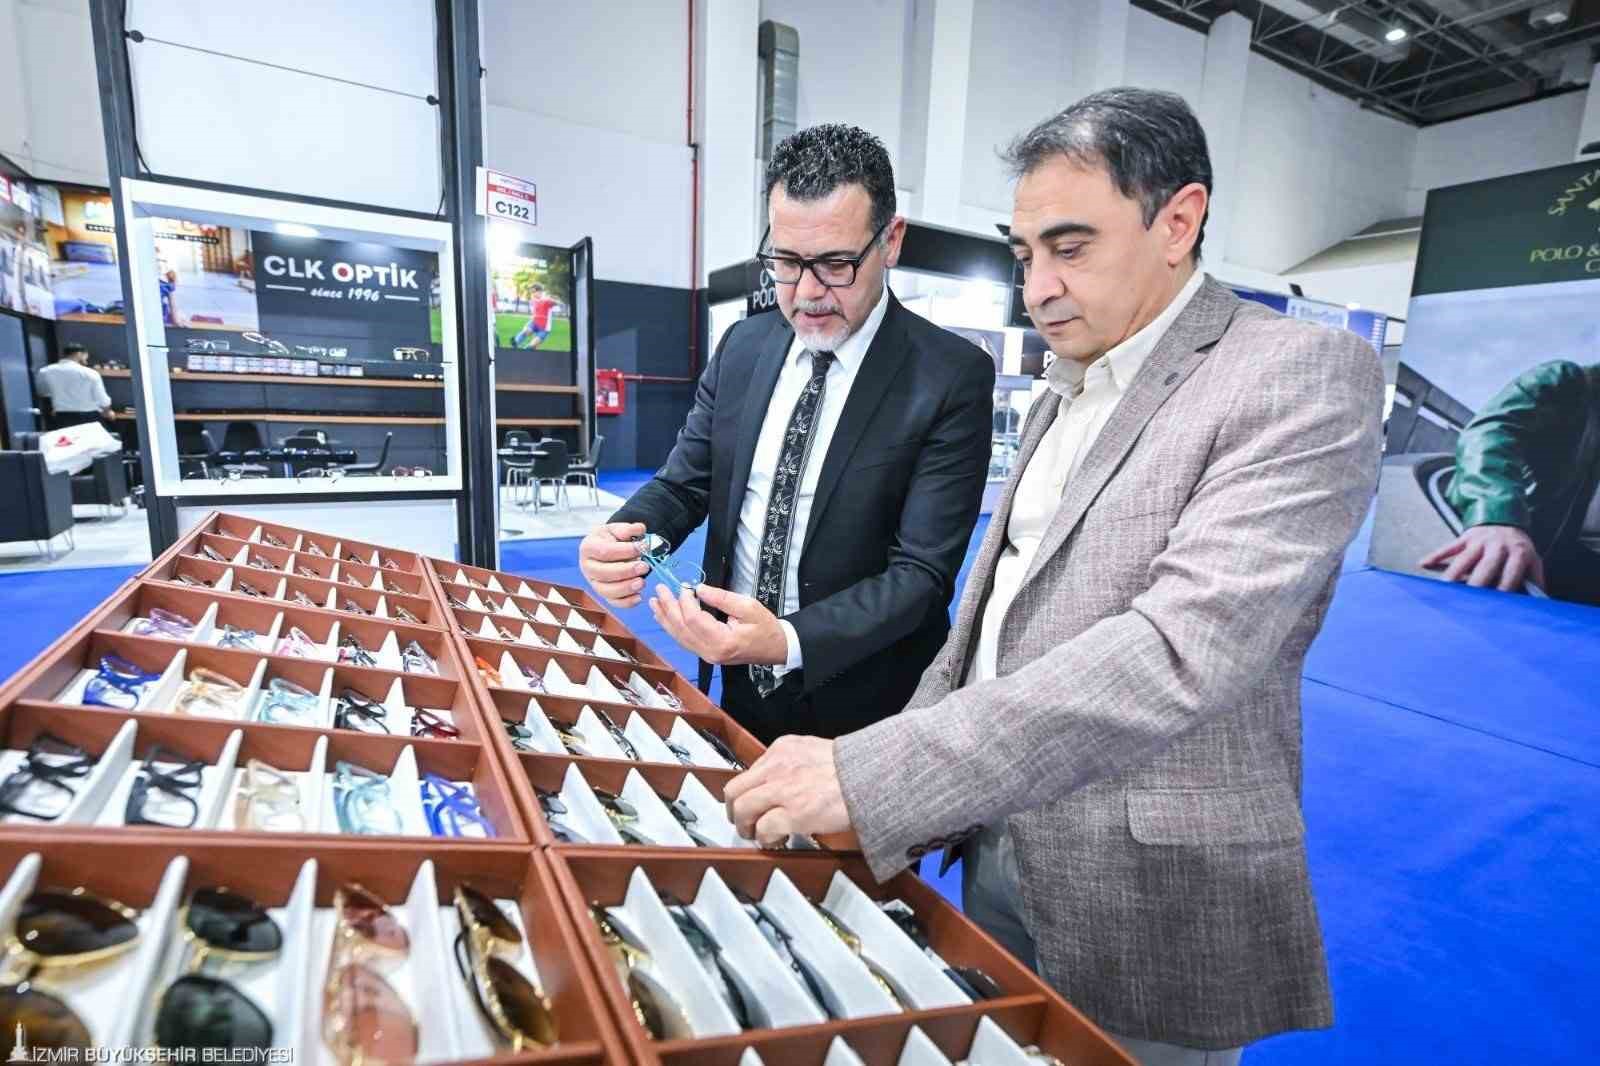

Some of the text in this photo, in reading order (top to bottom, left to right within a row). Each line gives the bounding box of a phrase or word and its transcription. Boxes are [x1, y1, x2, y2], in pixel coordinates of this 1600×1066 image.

[495, 200, 529, 219] C122
[1529, 245, 1583, 263] POLO
[263, 255, 419, 289] CLK OPTİK
[310, 287, 380, 302] since 1996
